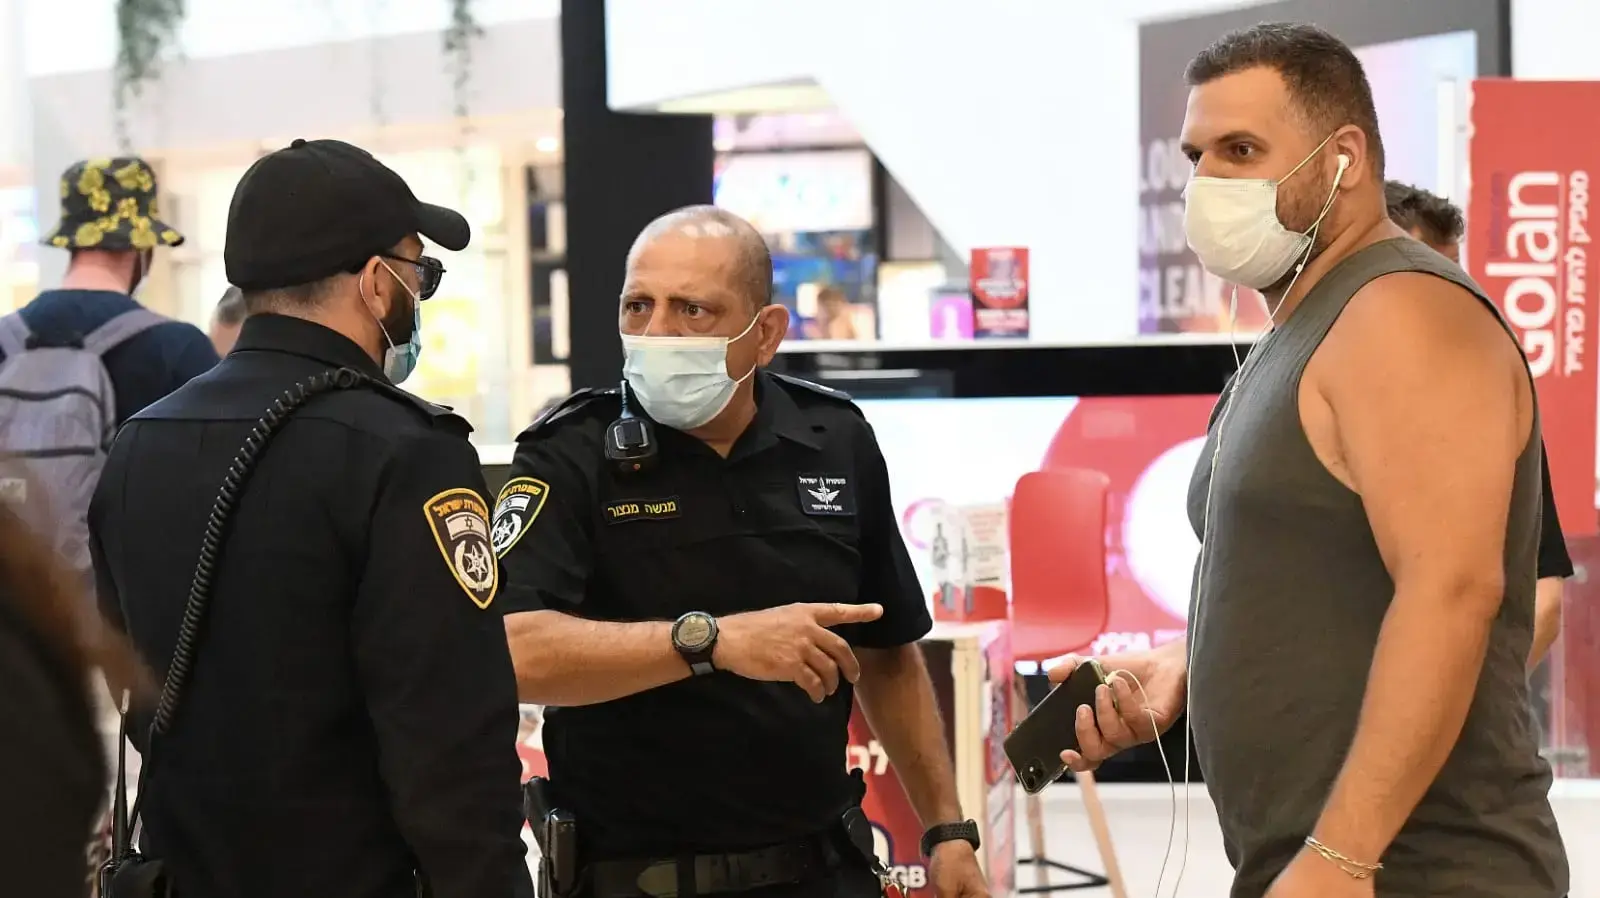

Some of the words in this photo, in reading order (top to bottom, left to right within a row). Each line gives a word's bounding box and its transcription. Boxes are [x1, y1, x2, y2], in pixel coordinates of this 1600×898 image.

[1485, 171, 1559, 379] Golan
[607, 504, 640, 517] מנצור
[644, 501, 677, 514] מנשה
